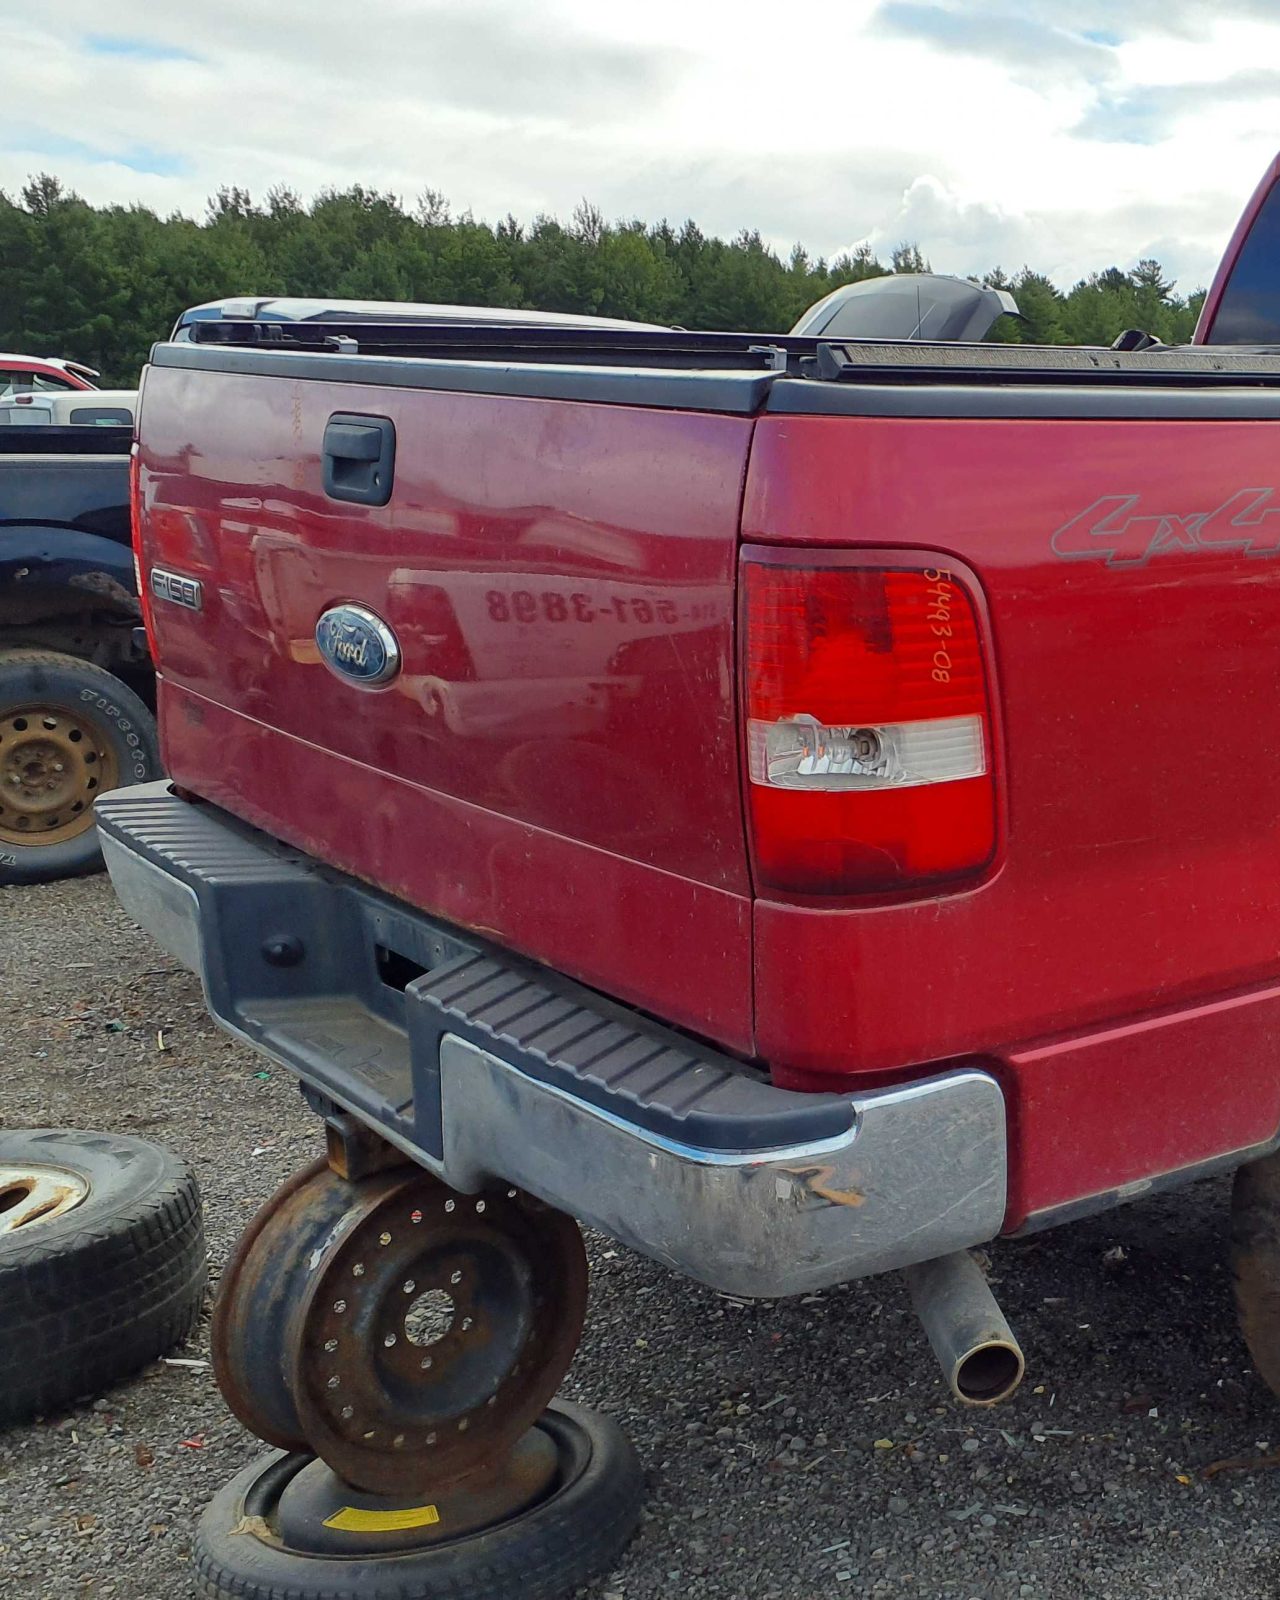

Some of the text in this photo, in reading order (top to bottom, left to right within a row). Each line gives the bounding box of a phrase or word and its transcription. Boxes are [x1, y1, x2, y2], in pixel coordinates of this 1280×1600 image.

[152, 571, 197, 608] F-150
[328, 620, 370, 667] Ford
[923, 568, 953, 684] 54493-08
[79, 688, 146, 780] Firesto
